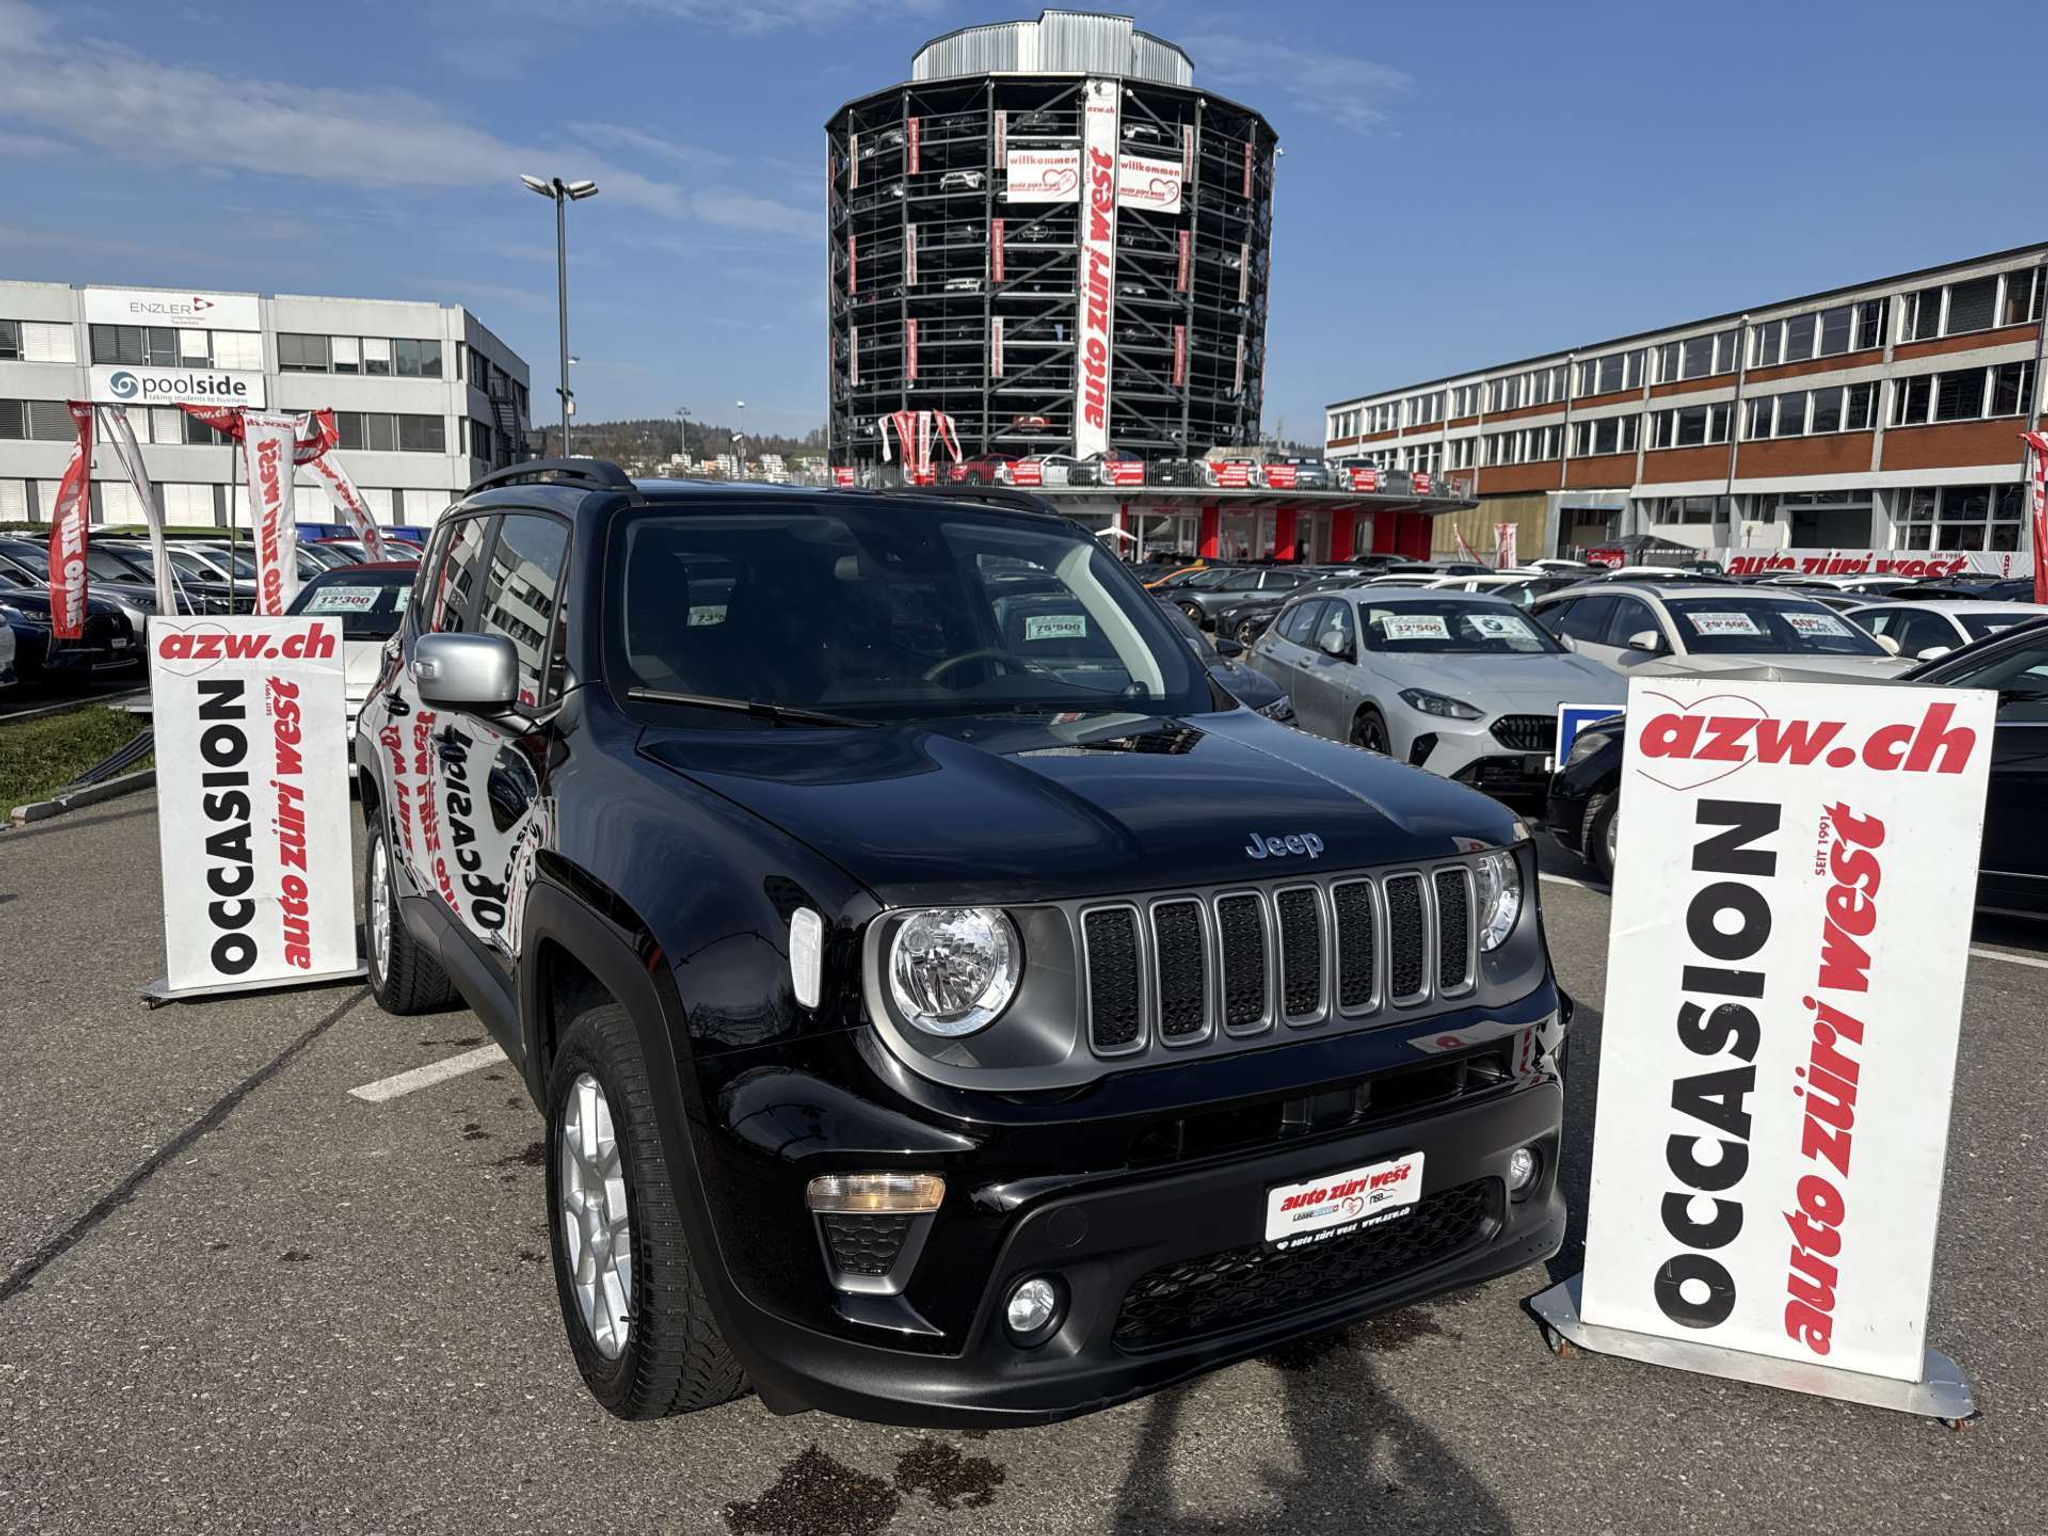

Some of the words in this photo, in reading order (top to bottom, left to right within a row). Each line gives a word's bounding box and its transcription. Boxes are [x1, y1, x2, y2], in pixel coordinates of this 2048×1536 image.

[1009, 156, 1078, 165] willkommen
[1090, 146, 1113, 241] west
[1120, 160, 1180, 177] willkommen
[130, 302, 192, 315] ENZLER
[1081, 246, 1110, 336] züri
[142, 374, 247, 399] poolside
[174, 395, 205, 403] students
[217, 396, 248, 404] business
[1082, 337, 1106, 430] auto
[158, 622, 336, 660] azw.ch
[265, 676, 303, 775] west
[1638, 702, 1977, 775] azw.ch
[197, 679, 258, 976] OCCASION
[268, 779, 308, 874] züri
[1245, 832, 1324, 859] Jeep
[1817, 815, 1831, 846] 1991
[1814, 850, 1828, 877] SEIT
[1817, 800, 1886, 993] west
[276, 874, 312, 971] auto
[1653, 797, 1782, 1330] OCCASION
[1793, 995, 1865, 1180] züri
[1280, 1186, 1328, 1212] auto
[1327, 1173, 1370, 1201] züri
[1370, 1162, 1413, 1188] west
[1290, 1235, 1313, 1248] auto
[1336, 1222, 1358, 1236] west
[1361, 1206, 1411, 1228] www.azw.ch
[1782, 1173, 1846, 1357] auto
